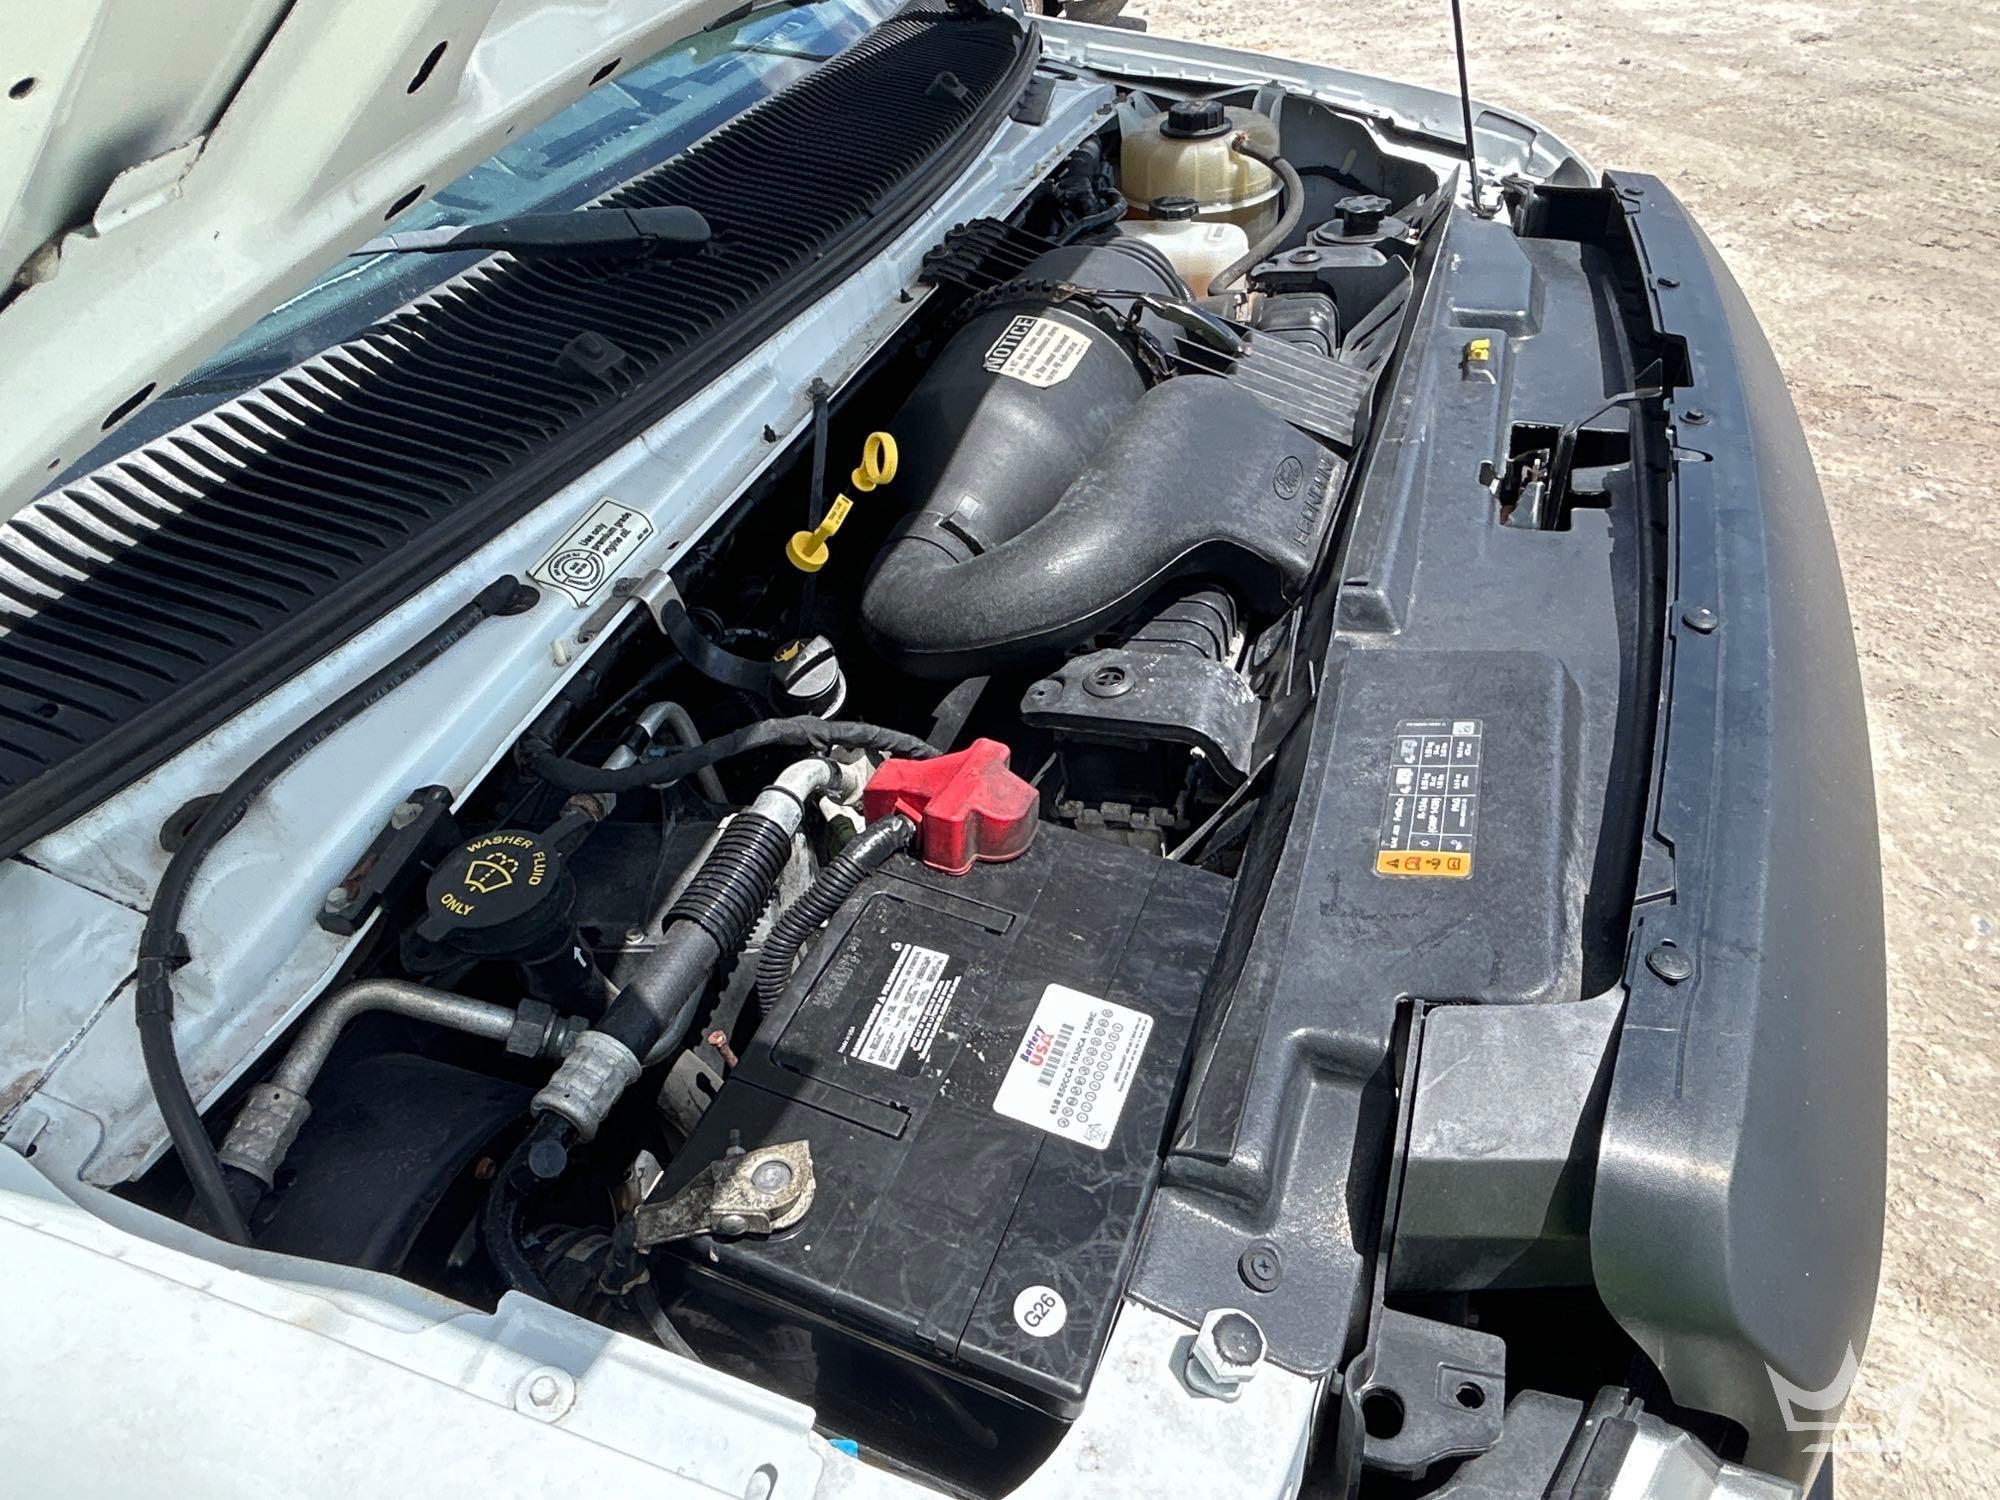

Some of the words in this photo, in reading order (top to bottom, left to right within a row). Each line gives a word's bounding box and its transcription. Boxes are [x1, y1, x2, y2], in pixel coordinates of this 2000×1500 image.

[987, 318, 1036, 369] NOTICE
[1275, 460, 1301, 496] Ford
[578, 535, 594, 546] Use
[592, 523, 607, 535] only
[591, 527, 617, 551] premium
[614, 512, 632, 528] grade
[602, 536, 623, 557] engine
[466, 836, 533, 852] WASHER
[528, 851, 546, 886] FLUID
[441, 893, 475, 915] ONLY
[1020, 1025, 1045, 1062] Battery
[1029, 1034, 1054, 1066] USA
[1057, 1068, 1074, 1098] 850CCA
[1070, 1037, 1086, 1065] 1030CA
[1024, 1293, 1056, 1327] G26
